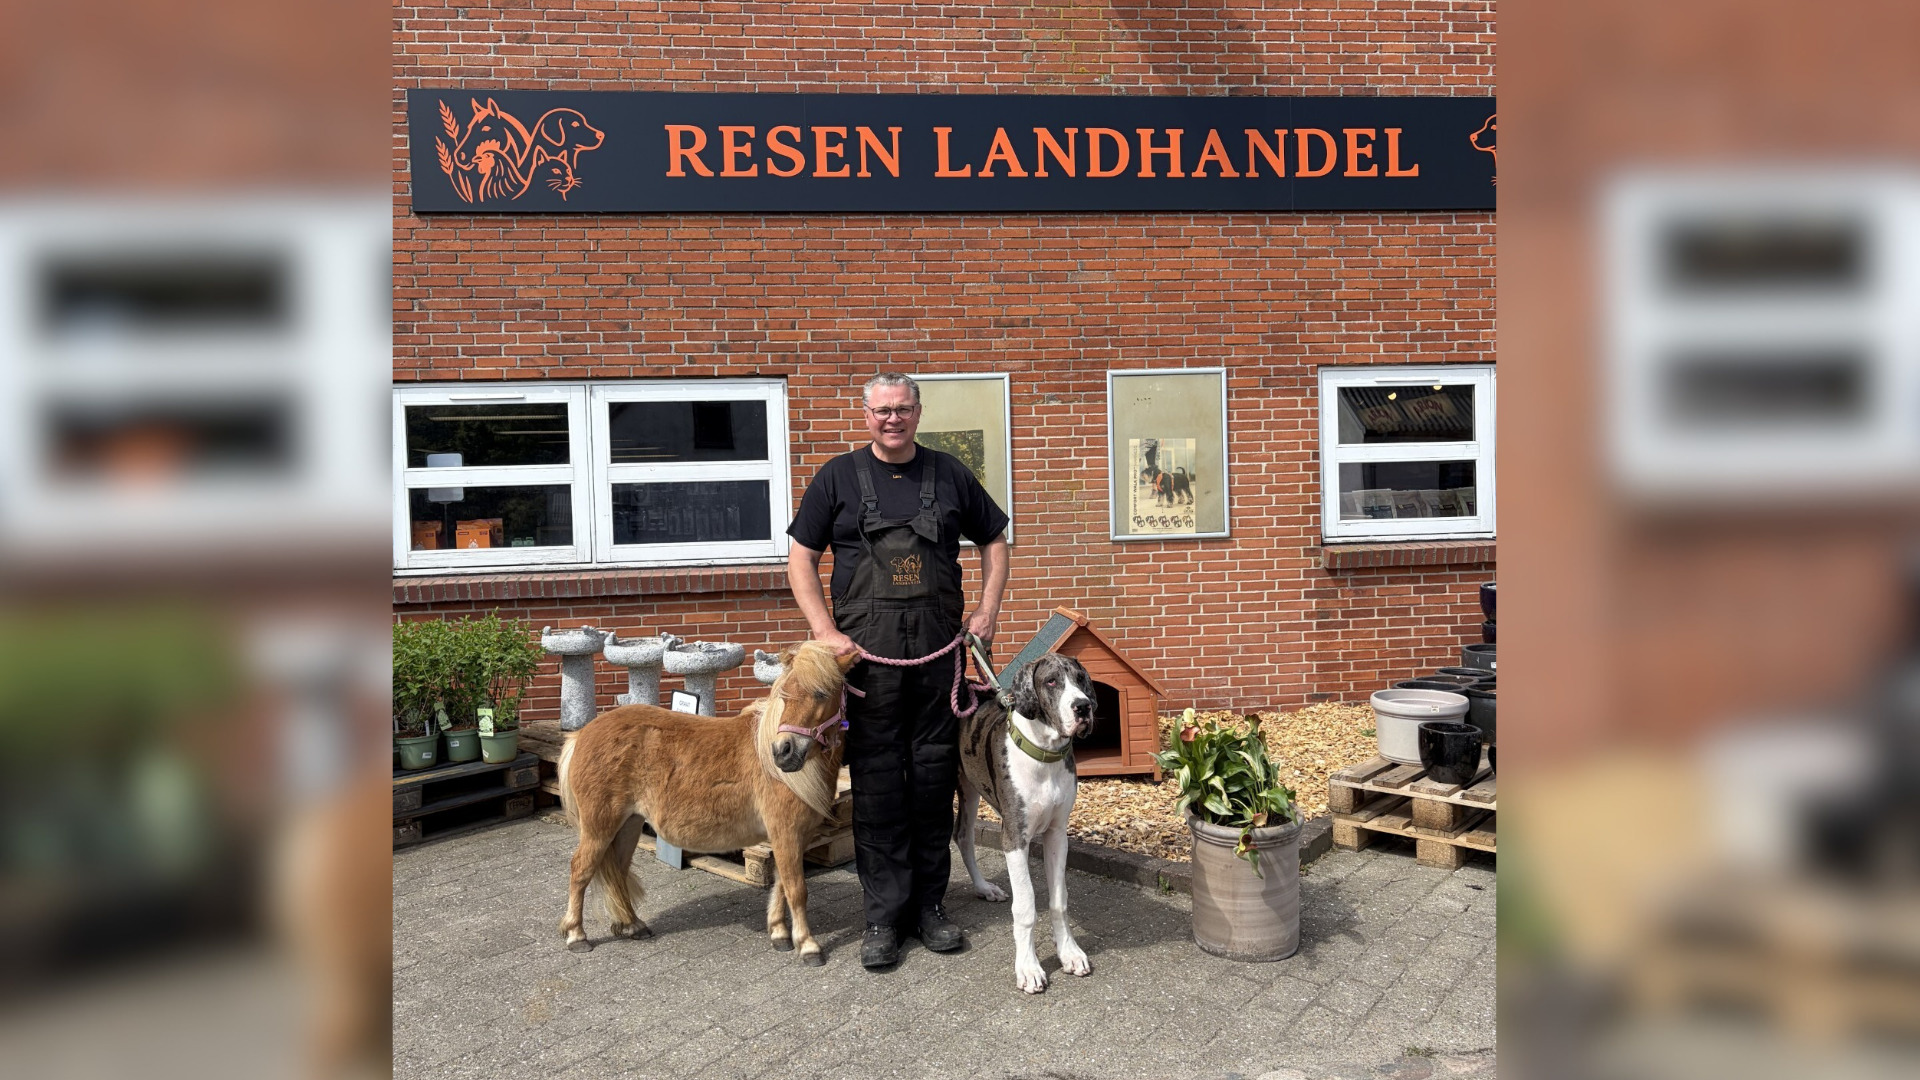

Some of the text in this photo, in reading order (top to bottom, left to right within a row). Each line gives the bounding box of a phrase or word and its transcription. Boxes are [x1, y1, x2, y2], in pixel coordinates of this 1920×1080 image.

[666, 126, 1419, 178] RESEN LANDHANDEL
[1413, 398, 1444, 417] ARION
[892, 574, 919, 582] RESEN
